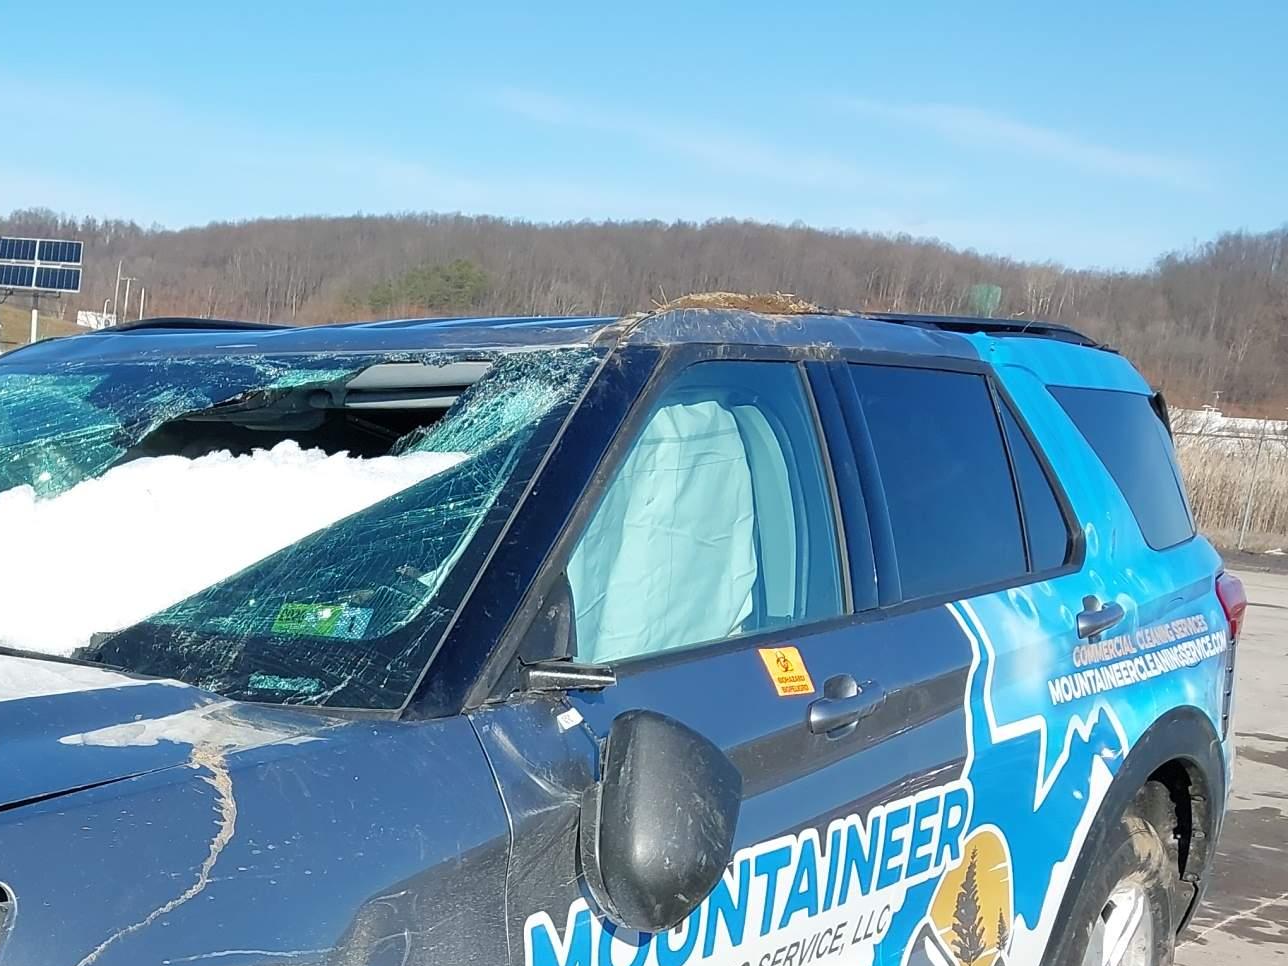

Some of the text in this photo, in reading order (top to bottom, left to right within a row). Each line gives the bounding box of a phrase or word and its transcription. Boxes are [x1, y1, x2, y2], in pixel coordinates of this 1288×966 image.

[1047, 630, 1227, 706] MOUNTAINEERCLEANINGSERVICE.COM
[1073, 614, 1210, 668] COMMERCIAL CLEANING SERVICES
[850, 904, 892, 946] LLC
